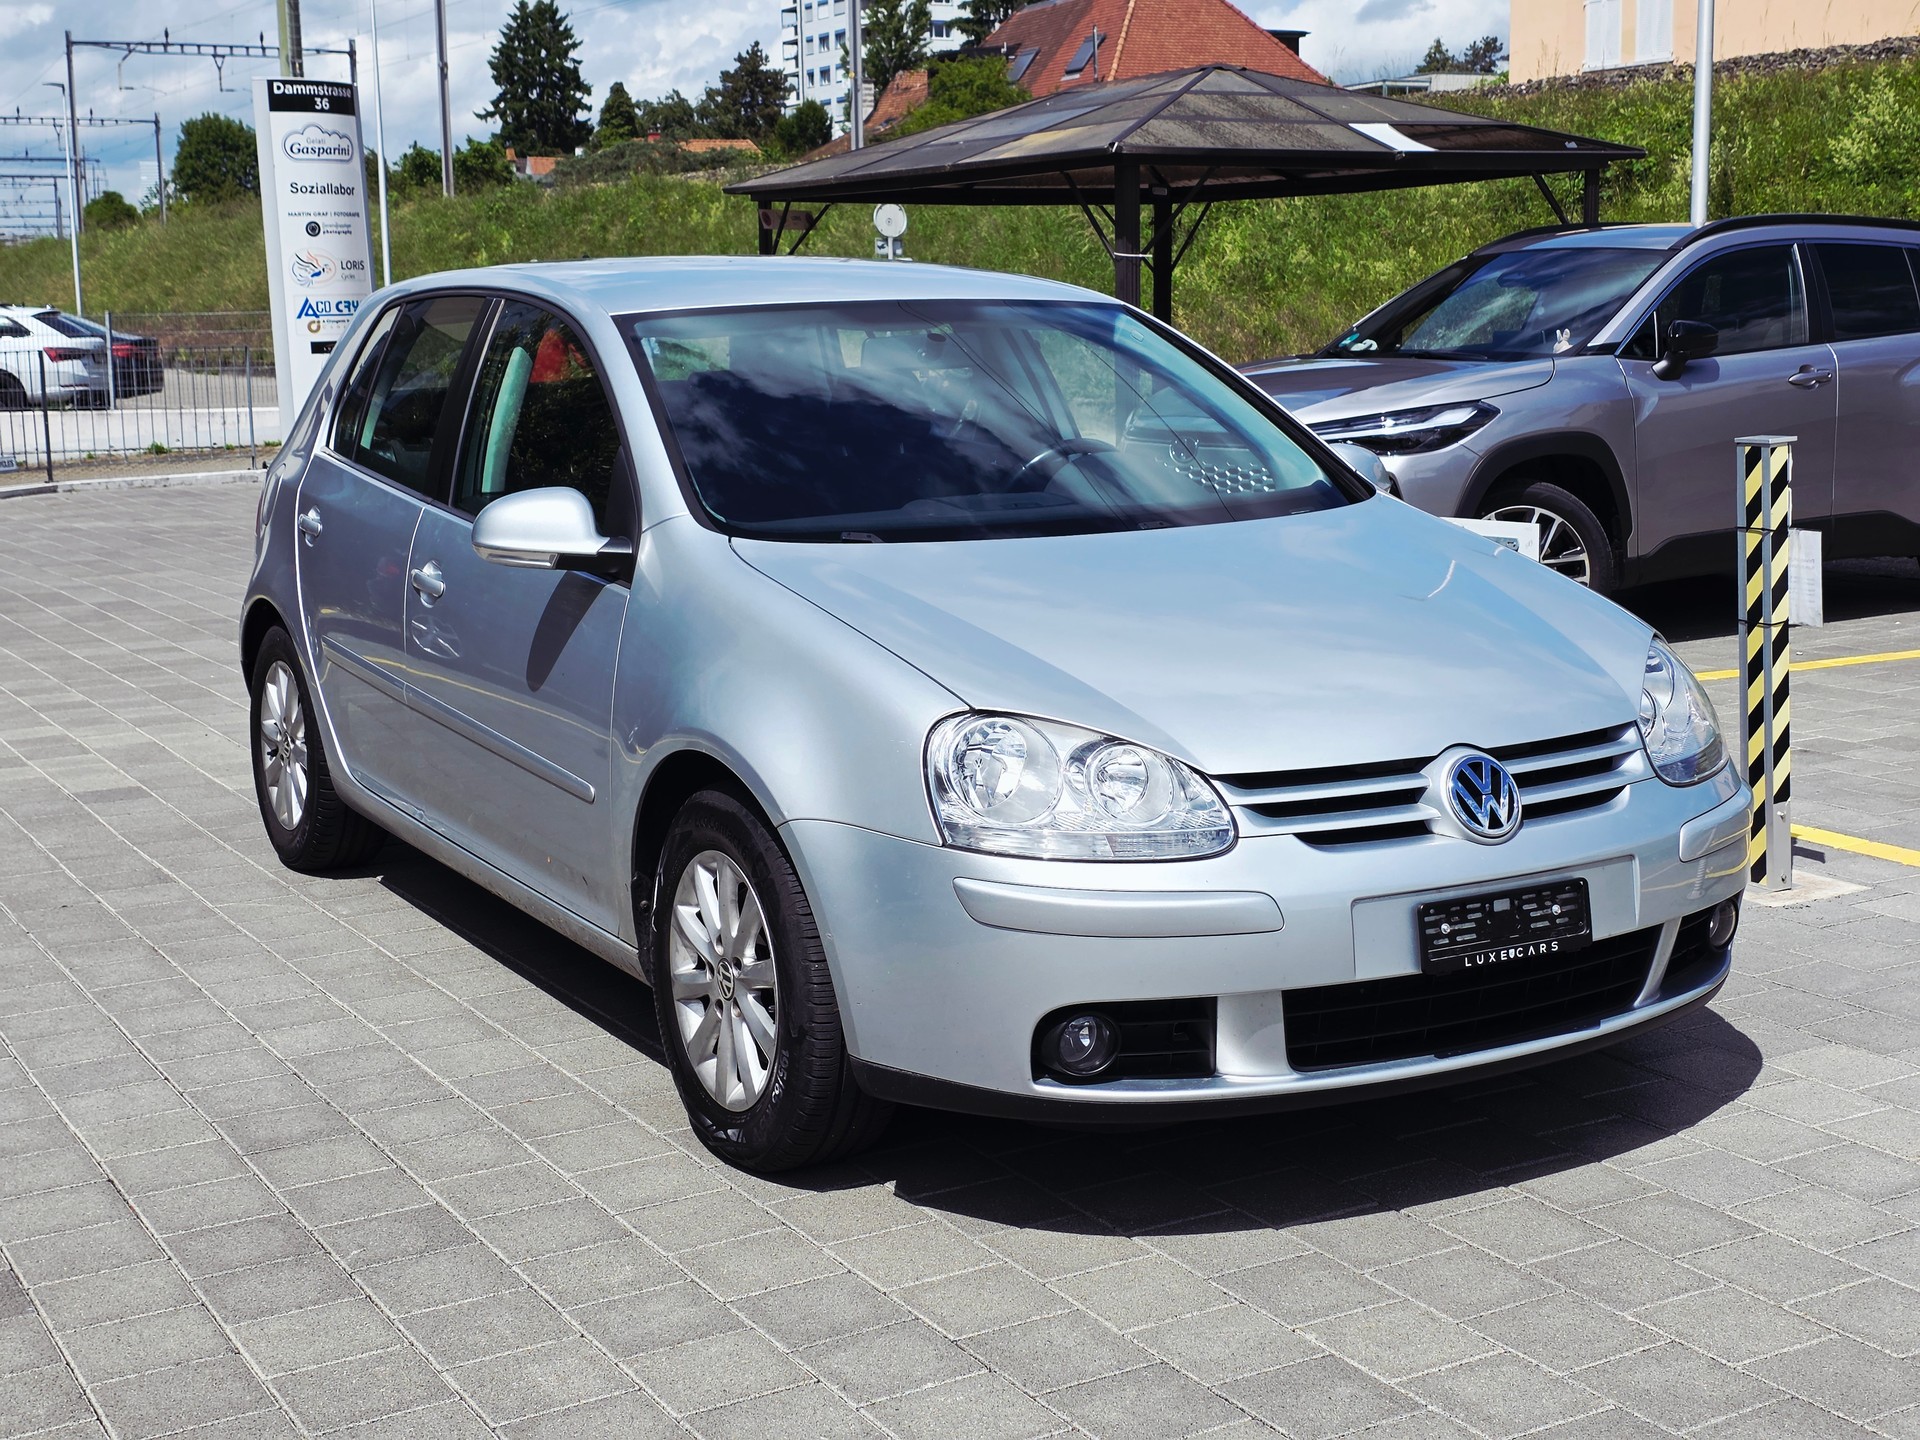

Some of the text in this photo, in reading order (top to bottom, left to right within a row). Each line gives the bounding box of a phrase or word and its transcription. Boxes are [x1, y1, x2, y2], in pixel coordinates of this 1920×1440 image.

[272, 81, 352, 98] Dammstrasse
[314, 97, 330, 110] 36
[290, 142, 350, 157] Gasparini
[290, 182, 355, 196] Soziallabor
[340, 259, 365, 271] LORIS
[335, 300, 360, 313] CRY
[1465, 941, 1559, 967] LUXE CARS
